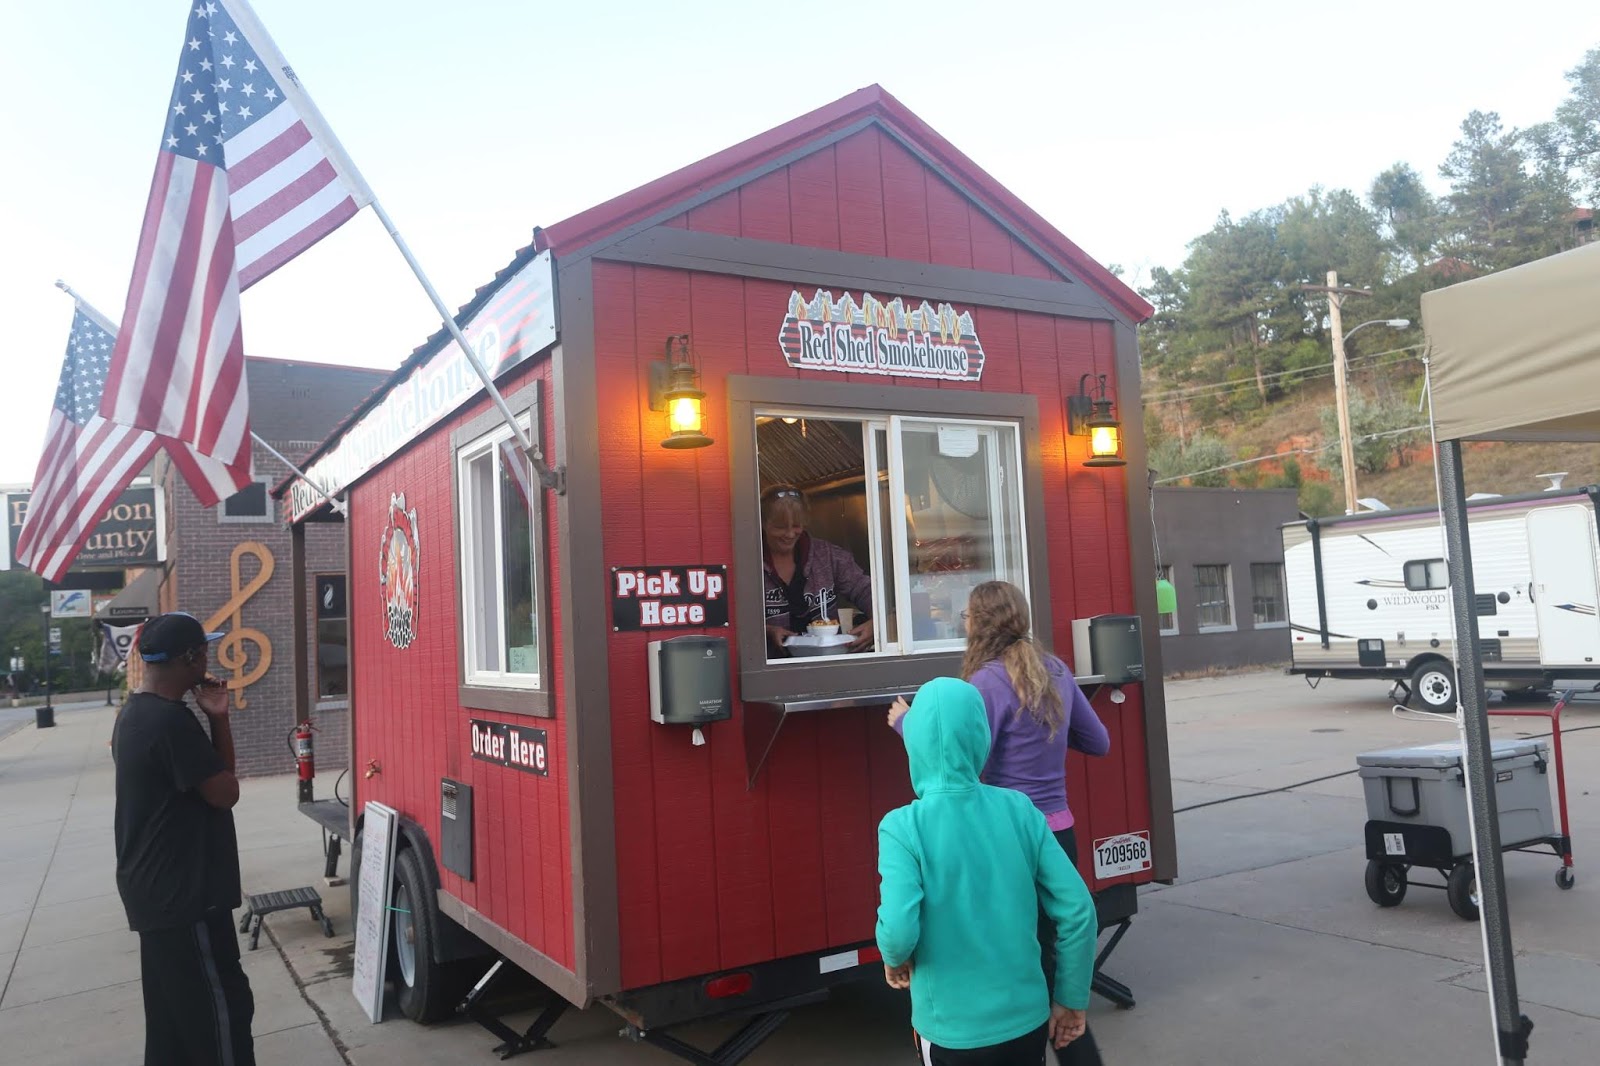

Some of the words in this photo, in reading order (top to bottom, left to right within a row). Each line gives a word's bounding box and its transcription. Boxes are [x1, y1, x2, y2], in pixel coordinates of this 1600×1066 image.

[801, 325, 833, 361] Red
[836, 329, 875, 364] Shed
[878, 332, 967, 372] Smokehouse
[86, 528, 154, 556] unty
[618, 571, 680, 596] Pick
[688, 570, 722, 598] Up
[641, 601, 704, 624] Here
[1384, 595, 1446, 606] WILDWOOD
[472, 724, 505, 759] Order
[510, 730, 545, 769] Here
[1098, 842, 1146, 866] T209568
